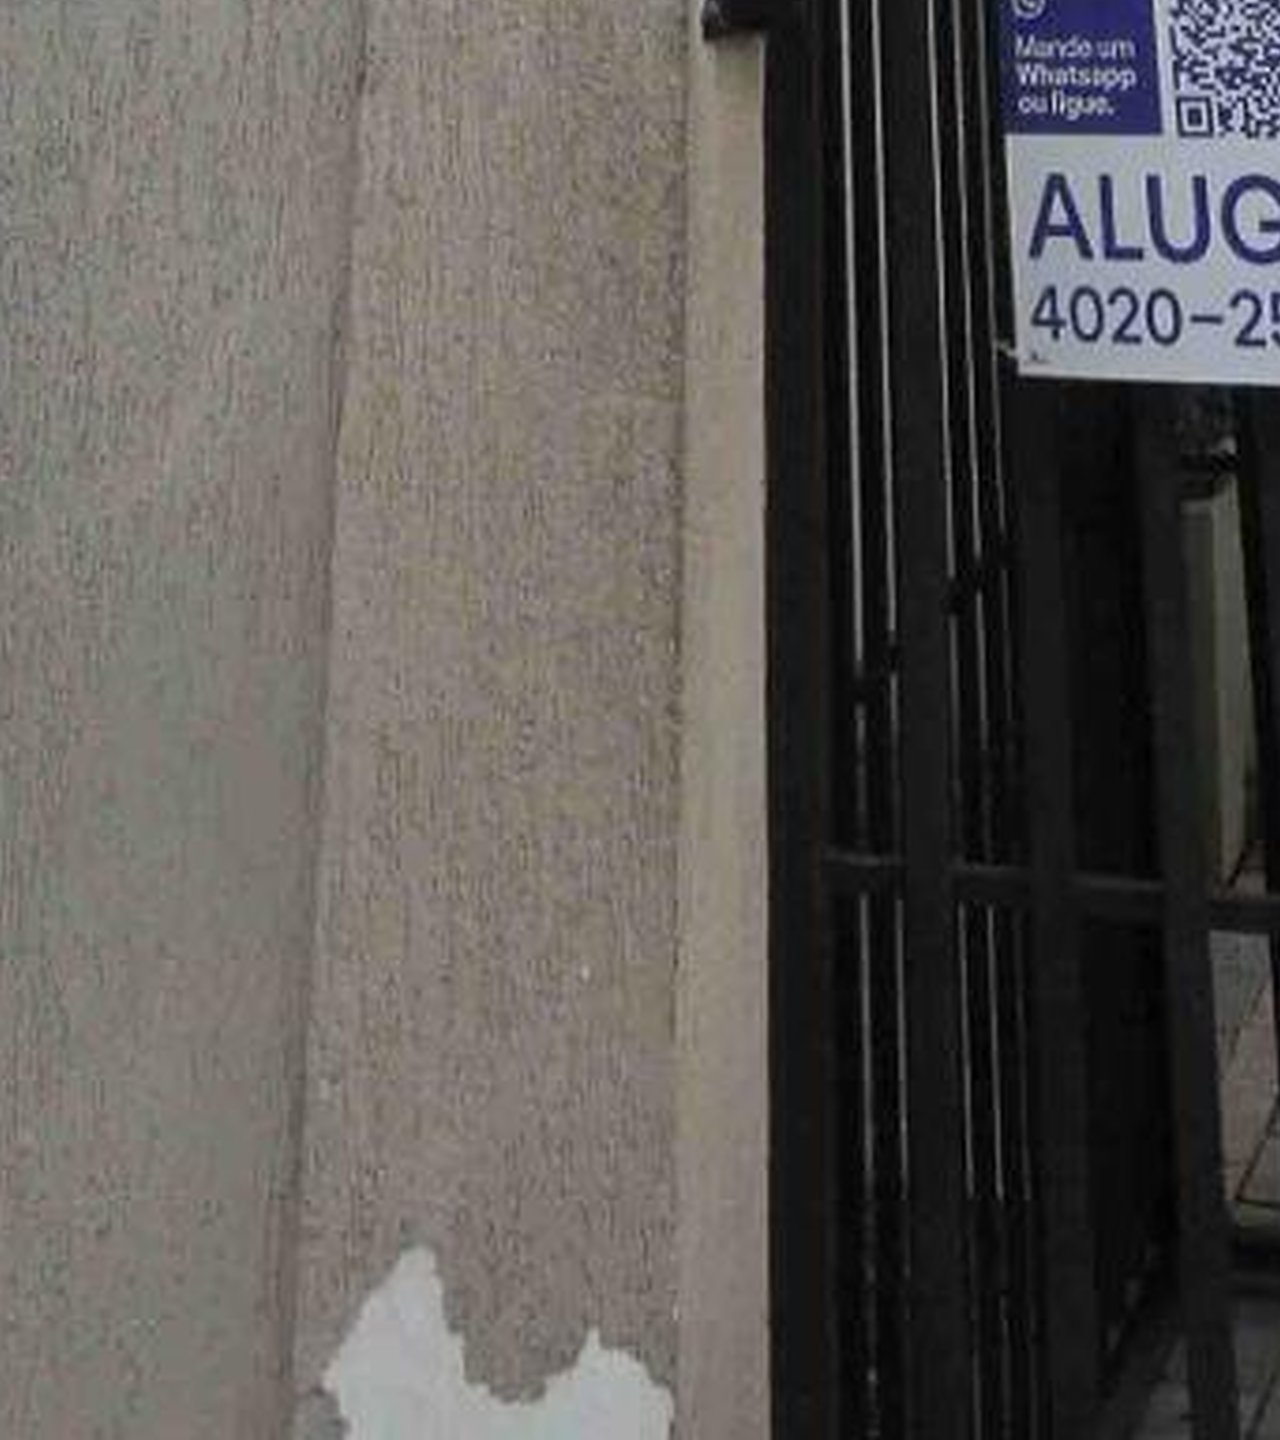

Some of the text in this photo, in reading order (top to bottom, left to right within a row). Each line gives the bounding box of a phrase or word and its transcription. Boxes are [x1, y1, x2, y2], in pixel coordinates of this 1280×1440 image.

[1015, 34, 1136, 60] Mande um
[1018, 96, 1048, 115] ou
